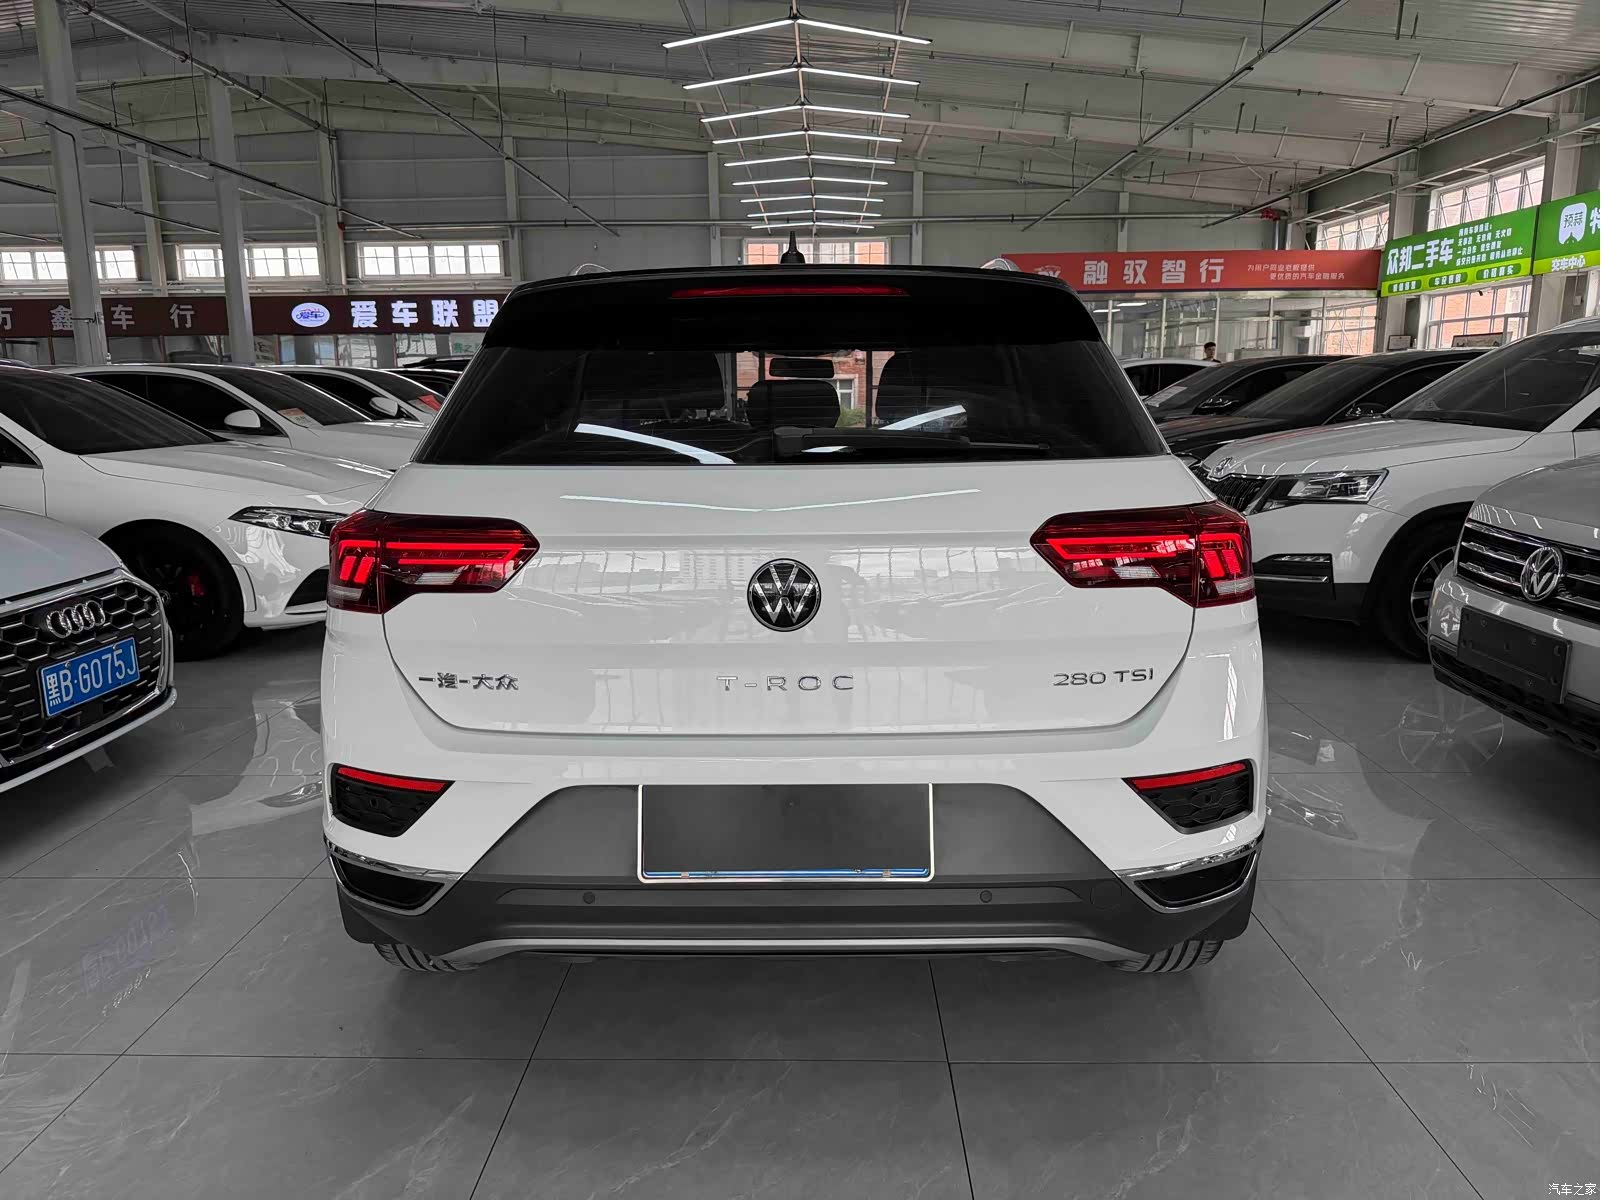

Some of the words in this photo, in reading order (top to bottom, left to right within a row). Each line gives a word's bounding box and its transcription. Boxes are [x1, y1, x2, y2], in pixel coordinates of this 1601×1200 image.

[1386, 237, 1454, 275] 众邦二手车
[1551, 254, 1586, 272] 交车中心
[1083, 258, 1225, 286] 融驭智行
[350, 299, 499, 328] 爱车联盟
[1052, 671, 1107, 687] 280
[1113, 667, 1154, 684] TSI
